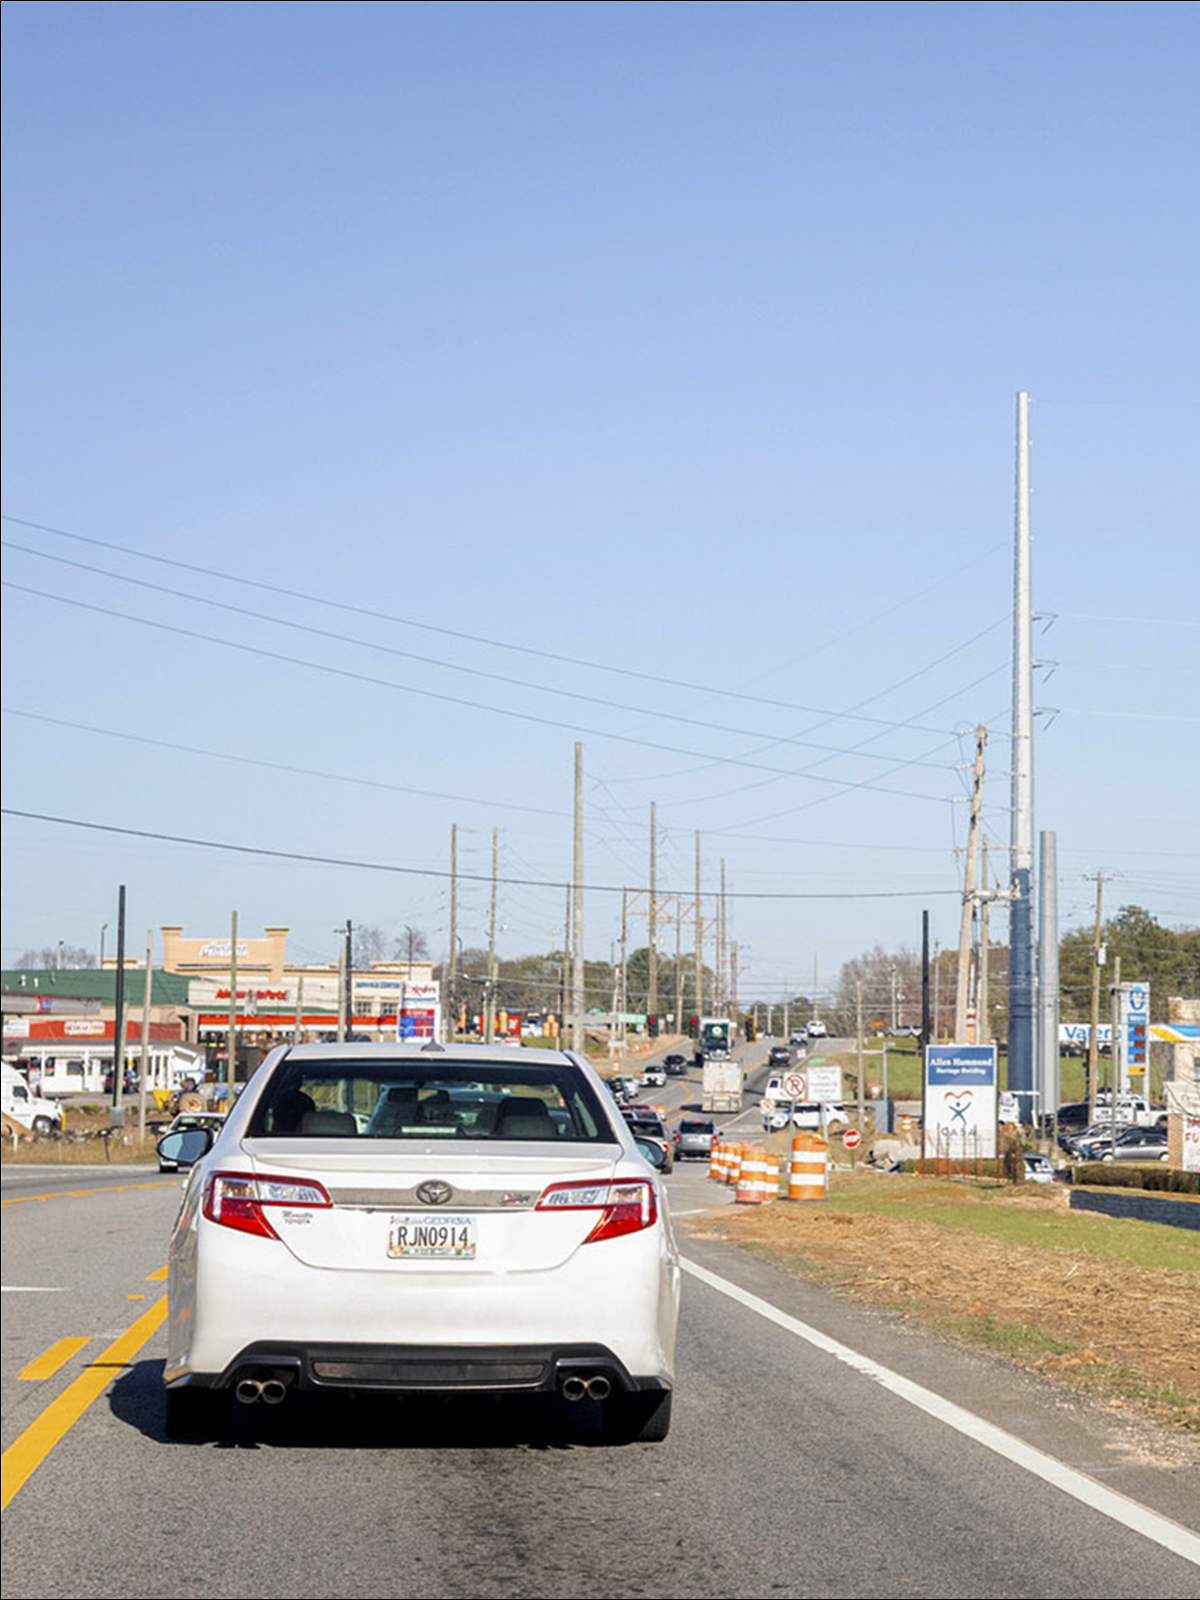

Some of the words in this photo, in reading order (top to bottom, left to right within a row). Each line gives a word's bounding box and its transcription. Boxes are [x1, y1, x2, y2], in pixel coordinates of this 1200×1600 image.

[1064, 1026, 1122, 1039] Valer
[930, 1058, 952, 1067] Allen
[953, 1058, 993, 1067] Hammond
[961, 1067, 986, 1076] Building
[423, 1216, 472, 1225] GEORGIA
[397, 1226, 469, 1247] RJN0914
